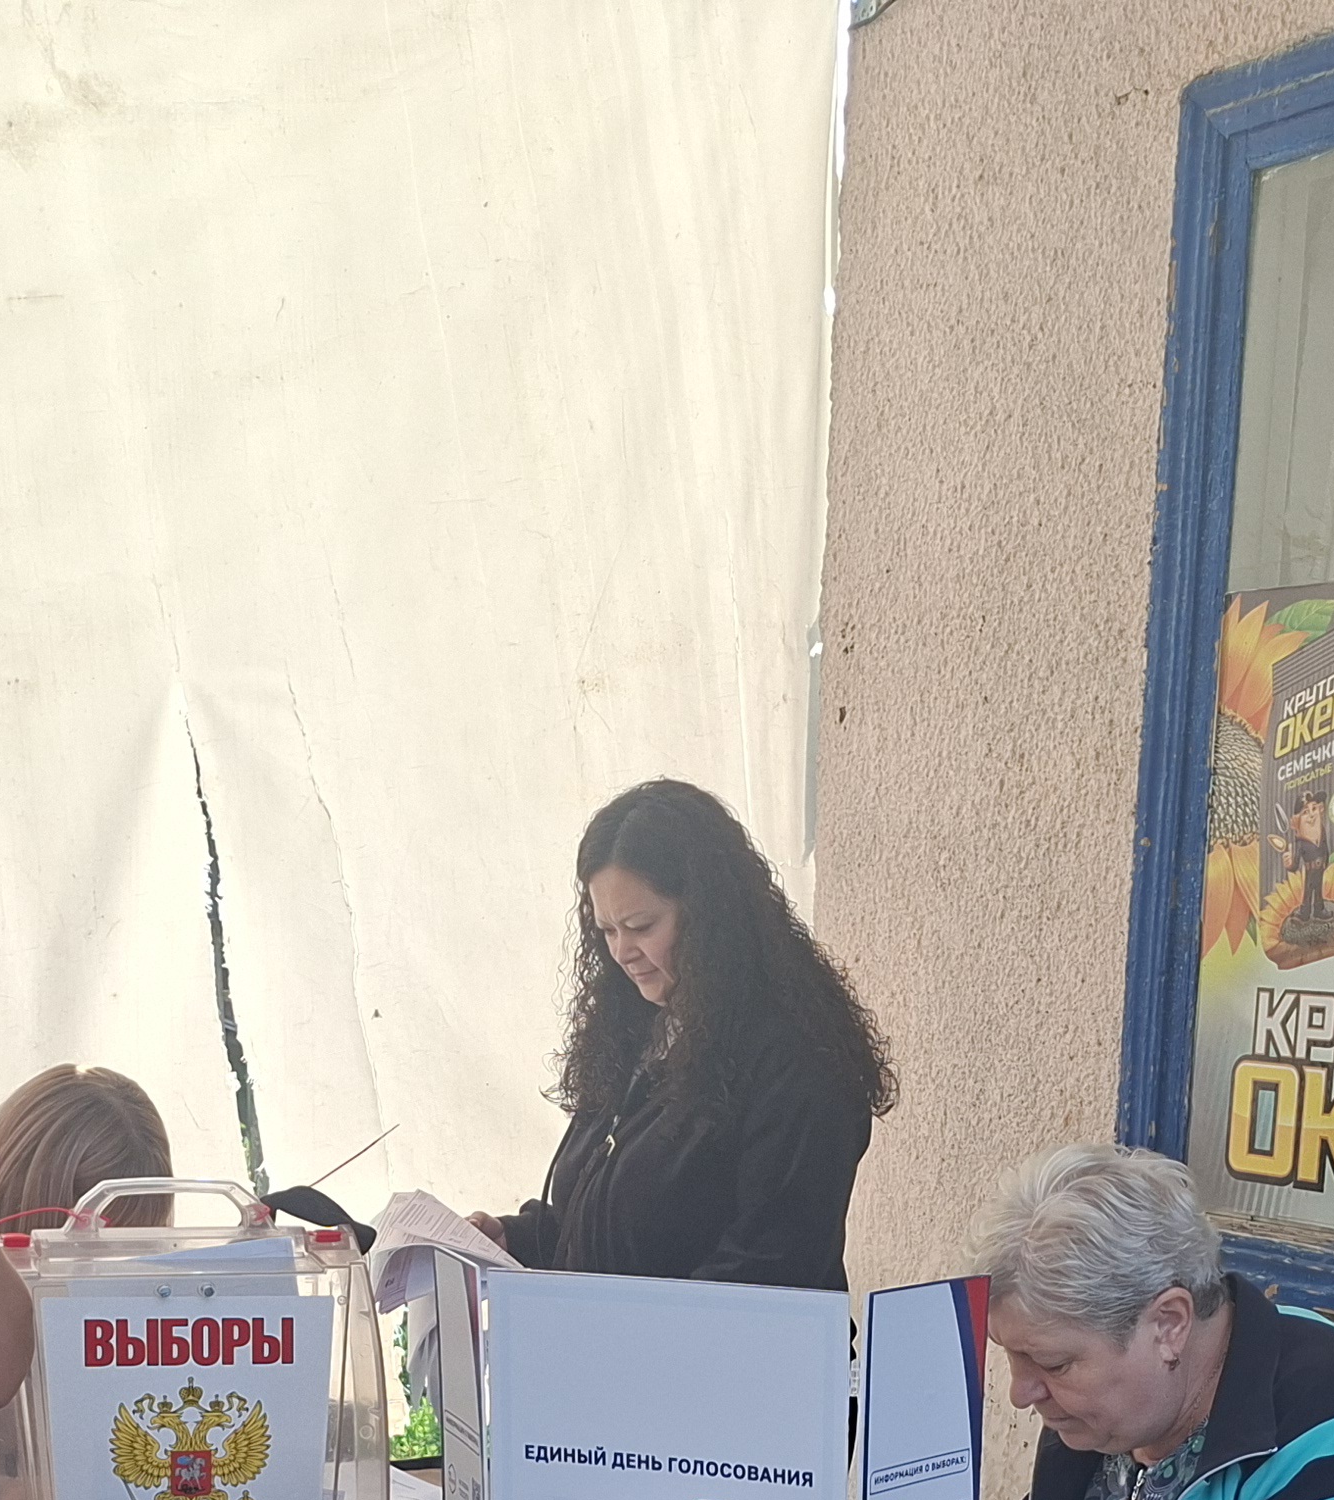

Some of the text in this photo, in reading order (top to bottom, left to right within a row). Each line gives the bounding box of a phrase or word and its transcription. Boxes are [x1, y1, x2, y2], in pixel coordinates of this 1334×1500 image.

[1283, 762, 1334, 791] ПОЛОСАТЫЕ
[83, 1317, 295, 1368] ВЫБОРЫ
[524, 1443, 815, 1489] ЕДИНЫЙ ДЕНЬ ГОЛОСОВАНИЯ
[874, 1465, 923, 1486] ИНФОРМАЦИЯ
[924, 1463, 930, 1472] О
